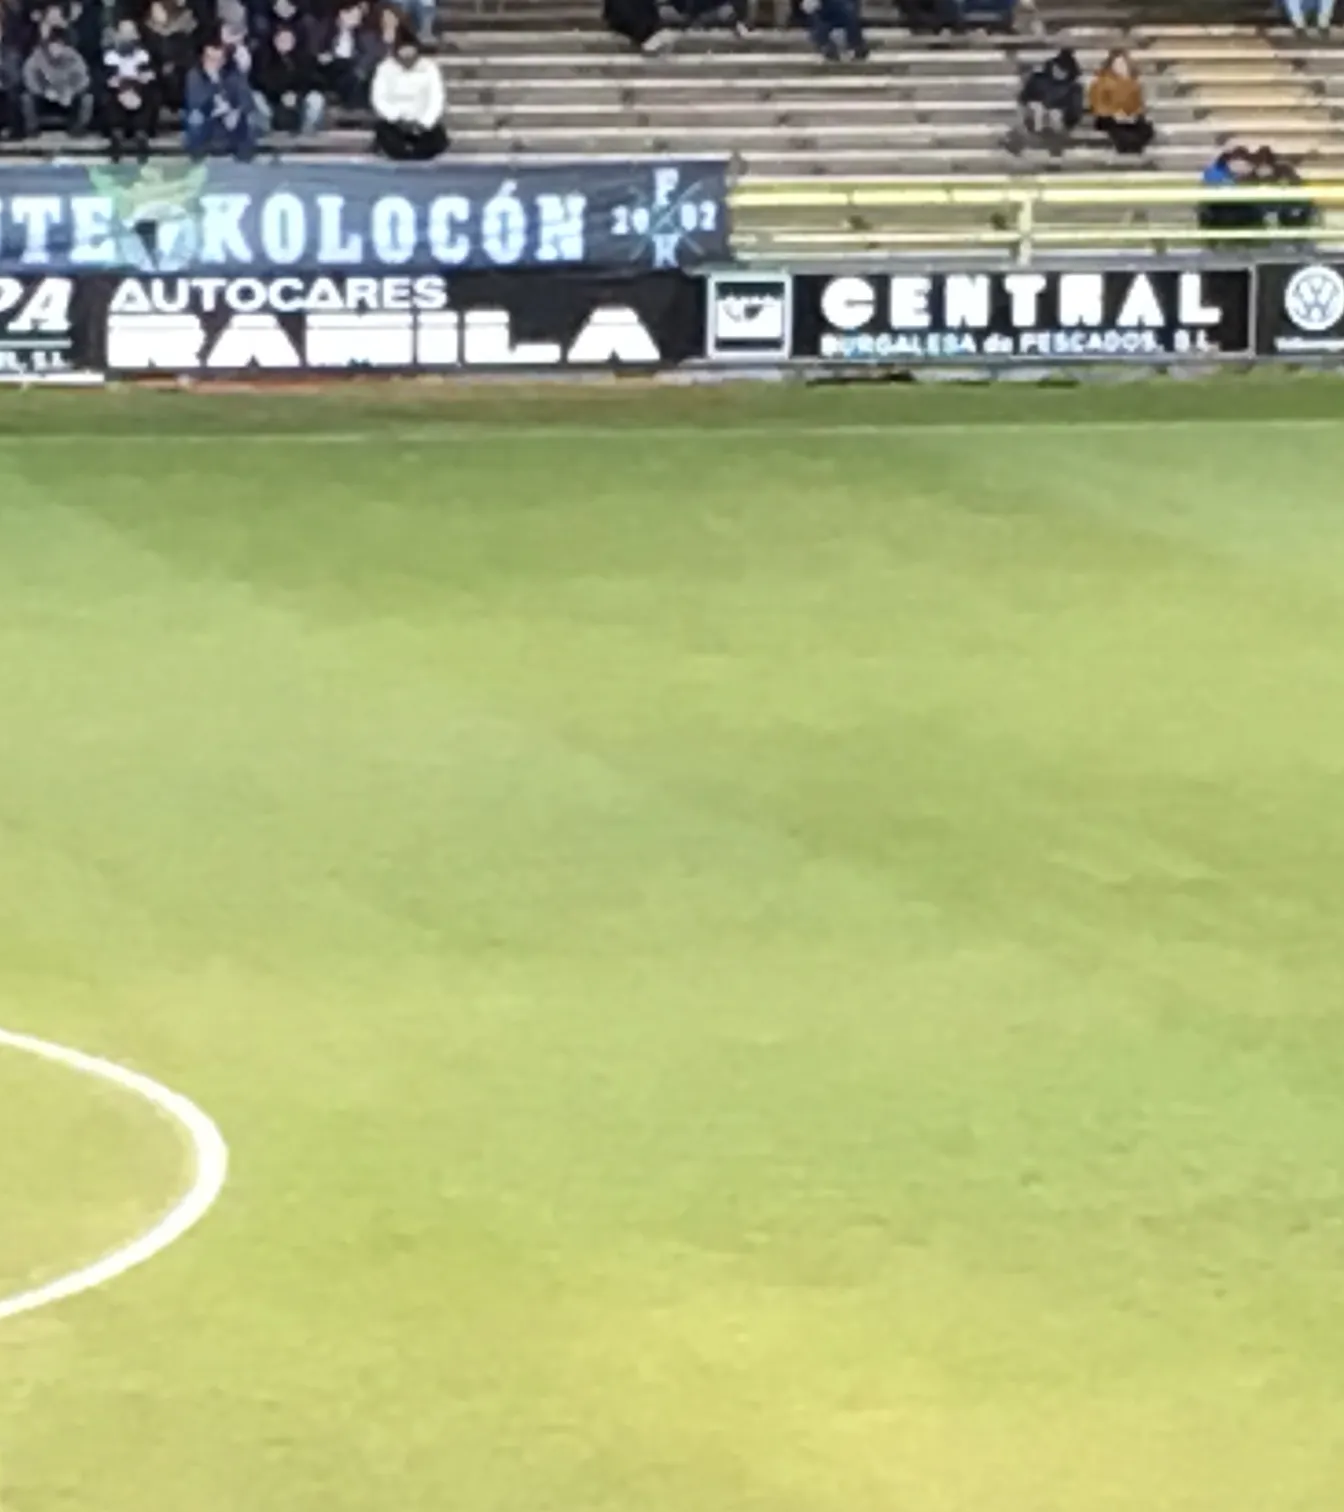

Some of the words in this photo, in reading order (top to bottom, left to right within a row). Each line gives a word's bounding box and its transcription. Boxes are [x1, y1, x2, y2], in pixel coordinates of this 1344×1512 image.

[199, 178, 587, 265] KOLOCÓN
[109, 277, 448, 311] AUTOCARES
[820, 273, 1222, 330] CENTRAL
